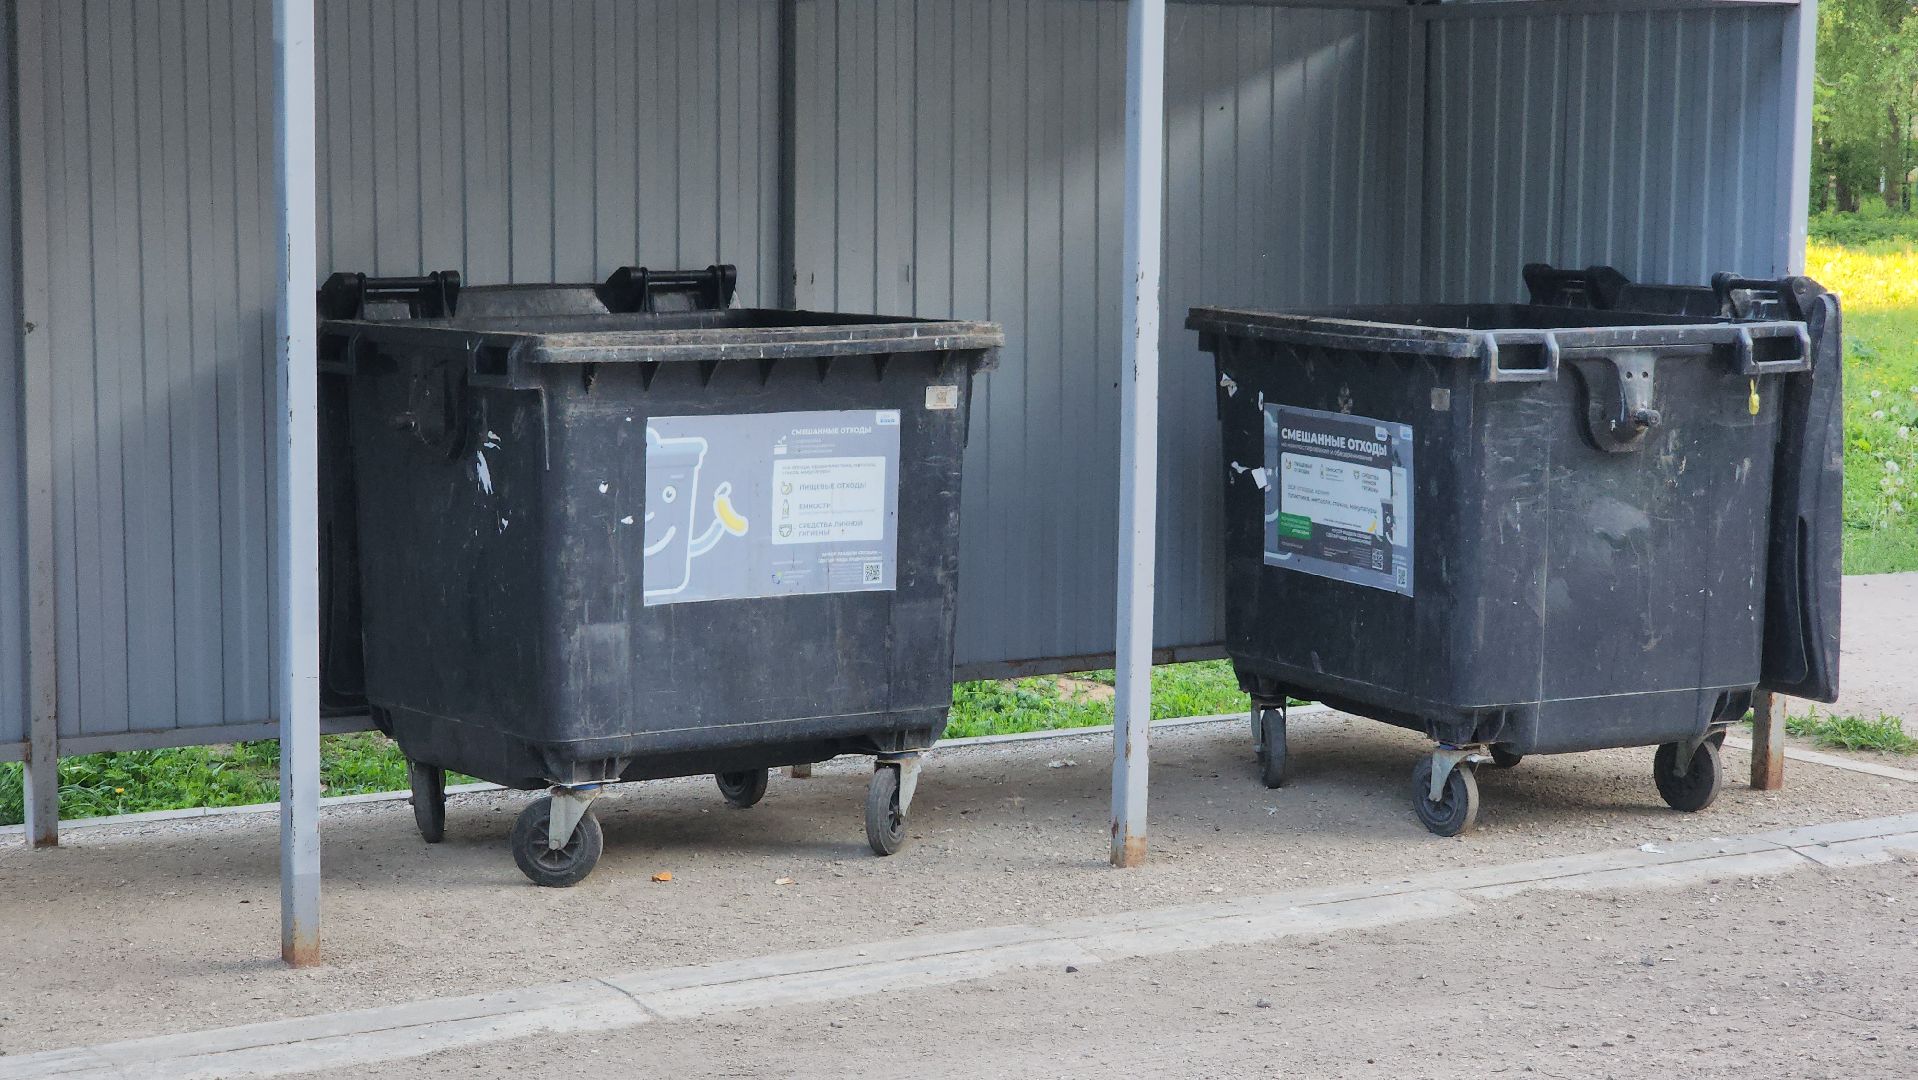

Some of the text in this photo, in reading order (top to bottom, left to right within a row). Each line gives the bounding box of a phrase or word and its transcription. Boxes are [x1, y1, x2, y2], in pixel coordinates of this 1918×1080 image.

[791, 426, 872, 436] СМЕШАННЫЕ ОТХОДЫ
[1281, 427, 1387, 457] СМЕШАННЫЕ ОТХОДЫ
